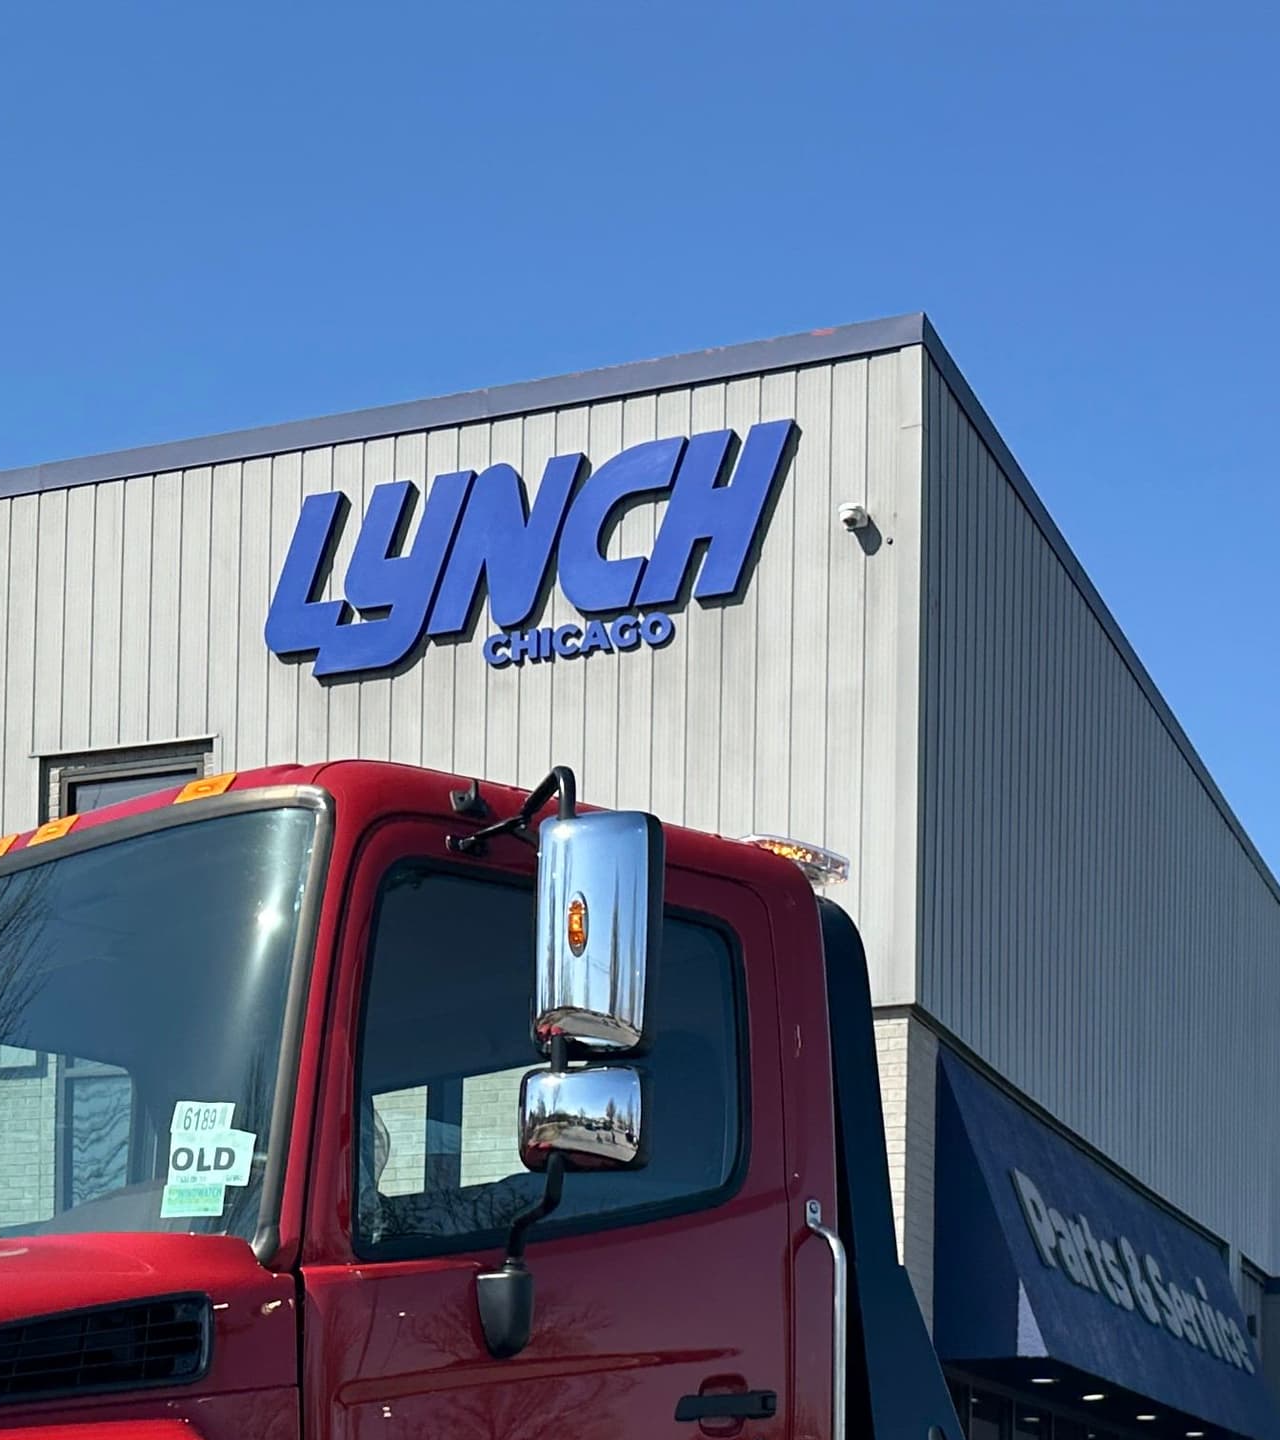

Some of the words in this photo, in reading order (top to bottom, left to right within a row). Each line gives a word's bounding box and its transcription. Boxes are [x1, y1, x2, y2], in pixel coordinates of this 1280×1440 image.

[265, 418, 801, 683] LYNCH
[483, 611, 675, 667] CHICAGO
[183, 1107, 218, 1131] 6189
[171, 1146, 236, 1172] OLD
[1010, 1167, 1134, 1311] Parts
[1119, 1236, 1162, 1327] &
[1145, 1253, 1255, 1375] Service
